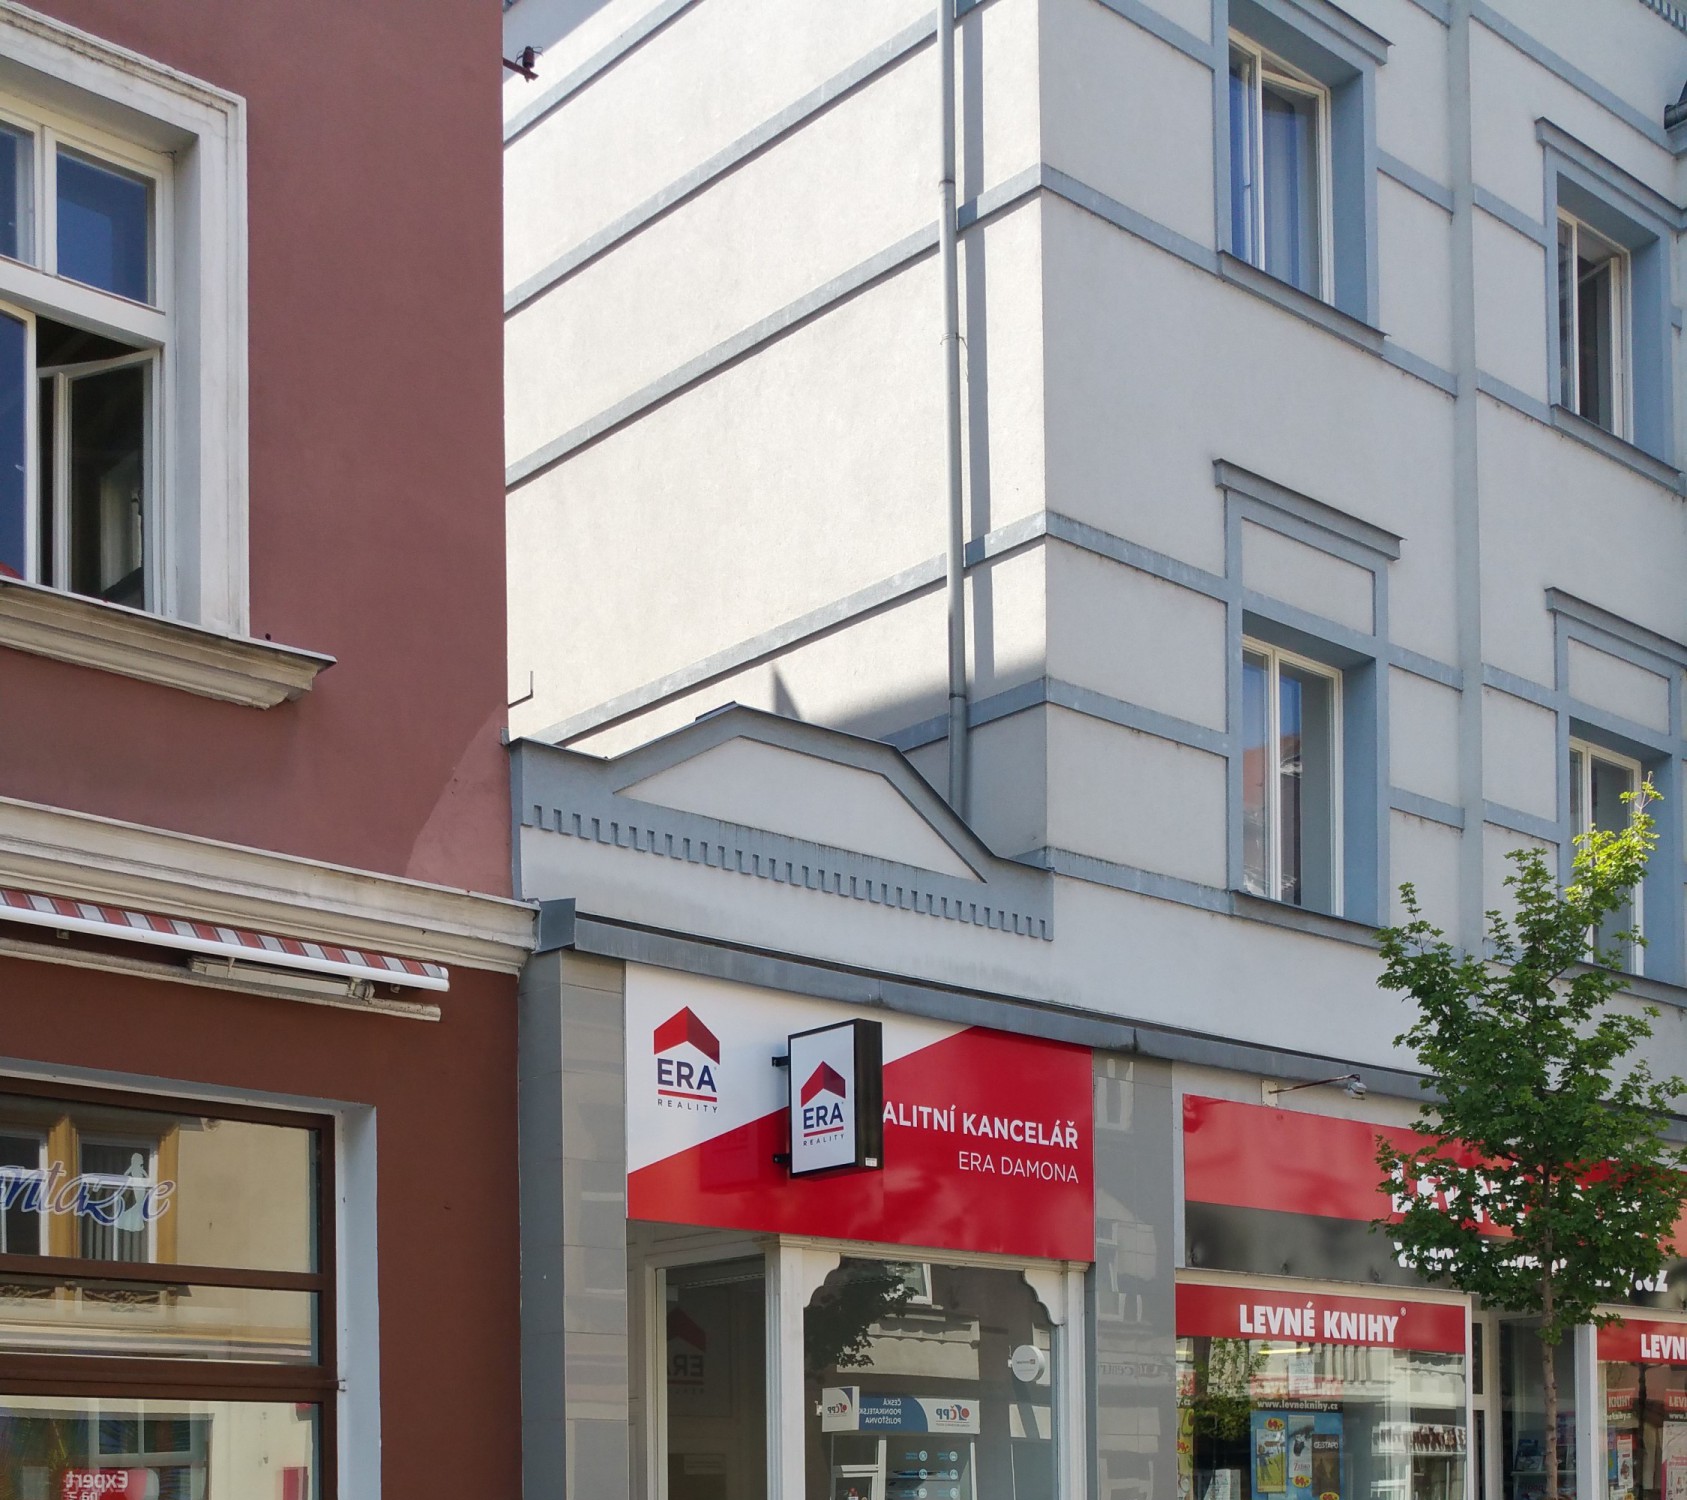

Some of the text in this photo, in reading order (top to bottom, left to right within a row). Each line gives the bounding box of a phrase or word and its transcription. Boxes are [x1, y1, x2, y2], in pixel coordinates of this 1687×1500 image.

[657, 1058, 717, 1093] ERA
[657, 1098, 719, 1114] REALITY
[803, 1102, 844, 1130] ERA
[803, 1133, 845, 1147] REALITY
[962, 1112, 1079, 1150] KANCELÁŘ
[958, 1151, 1079, 1184] ERA DAMONA
[1239, 1301, 1399, 1343] LEVNÉ KNIHY
[1640, 1333, 1687, 1360] LEVN
[1257, 1399, 1339, 1412] www.levneknihy.cz
